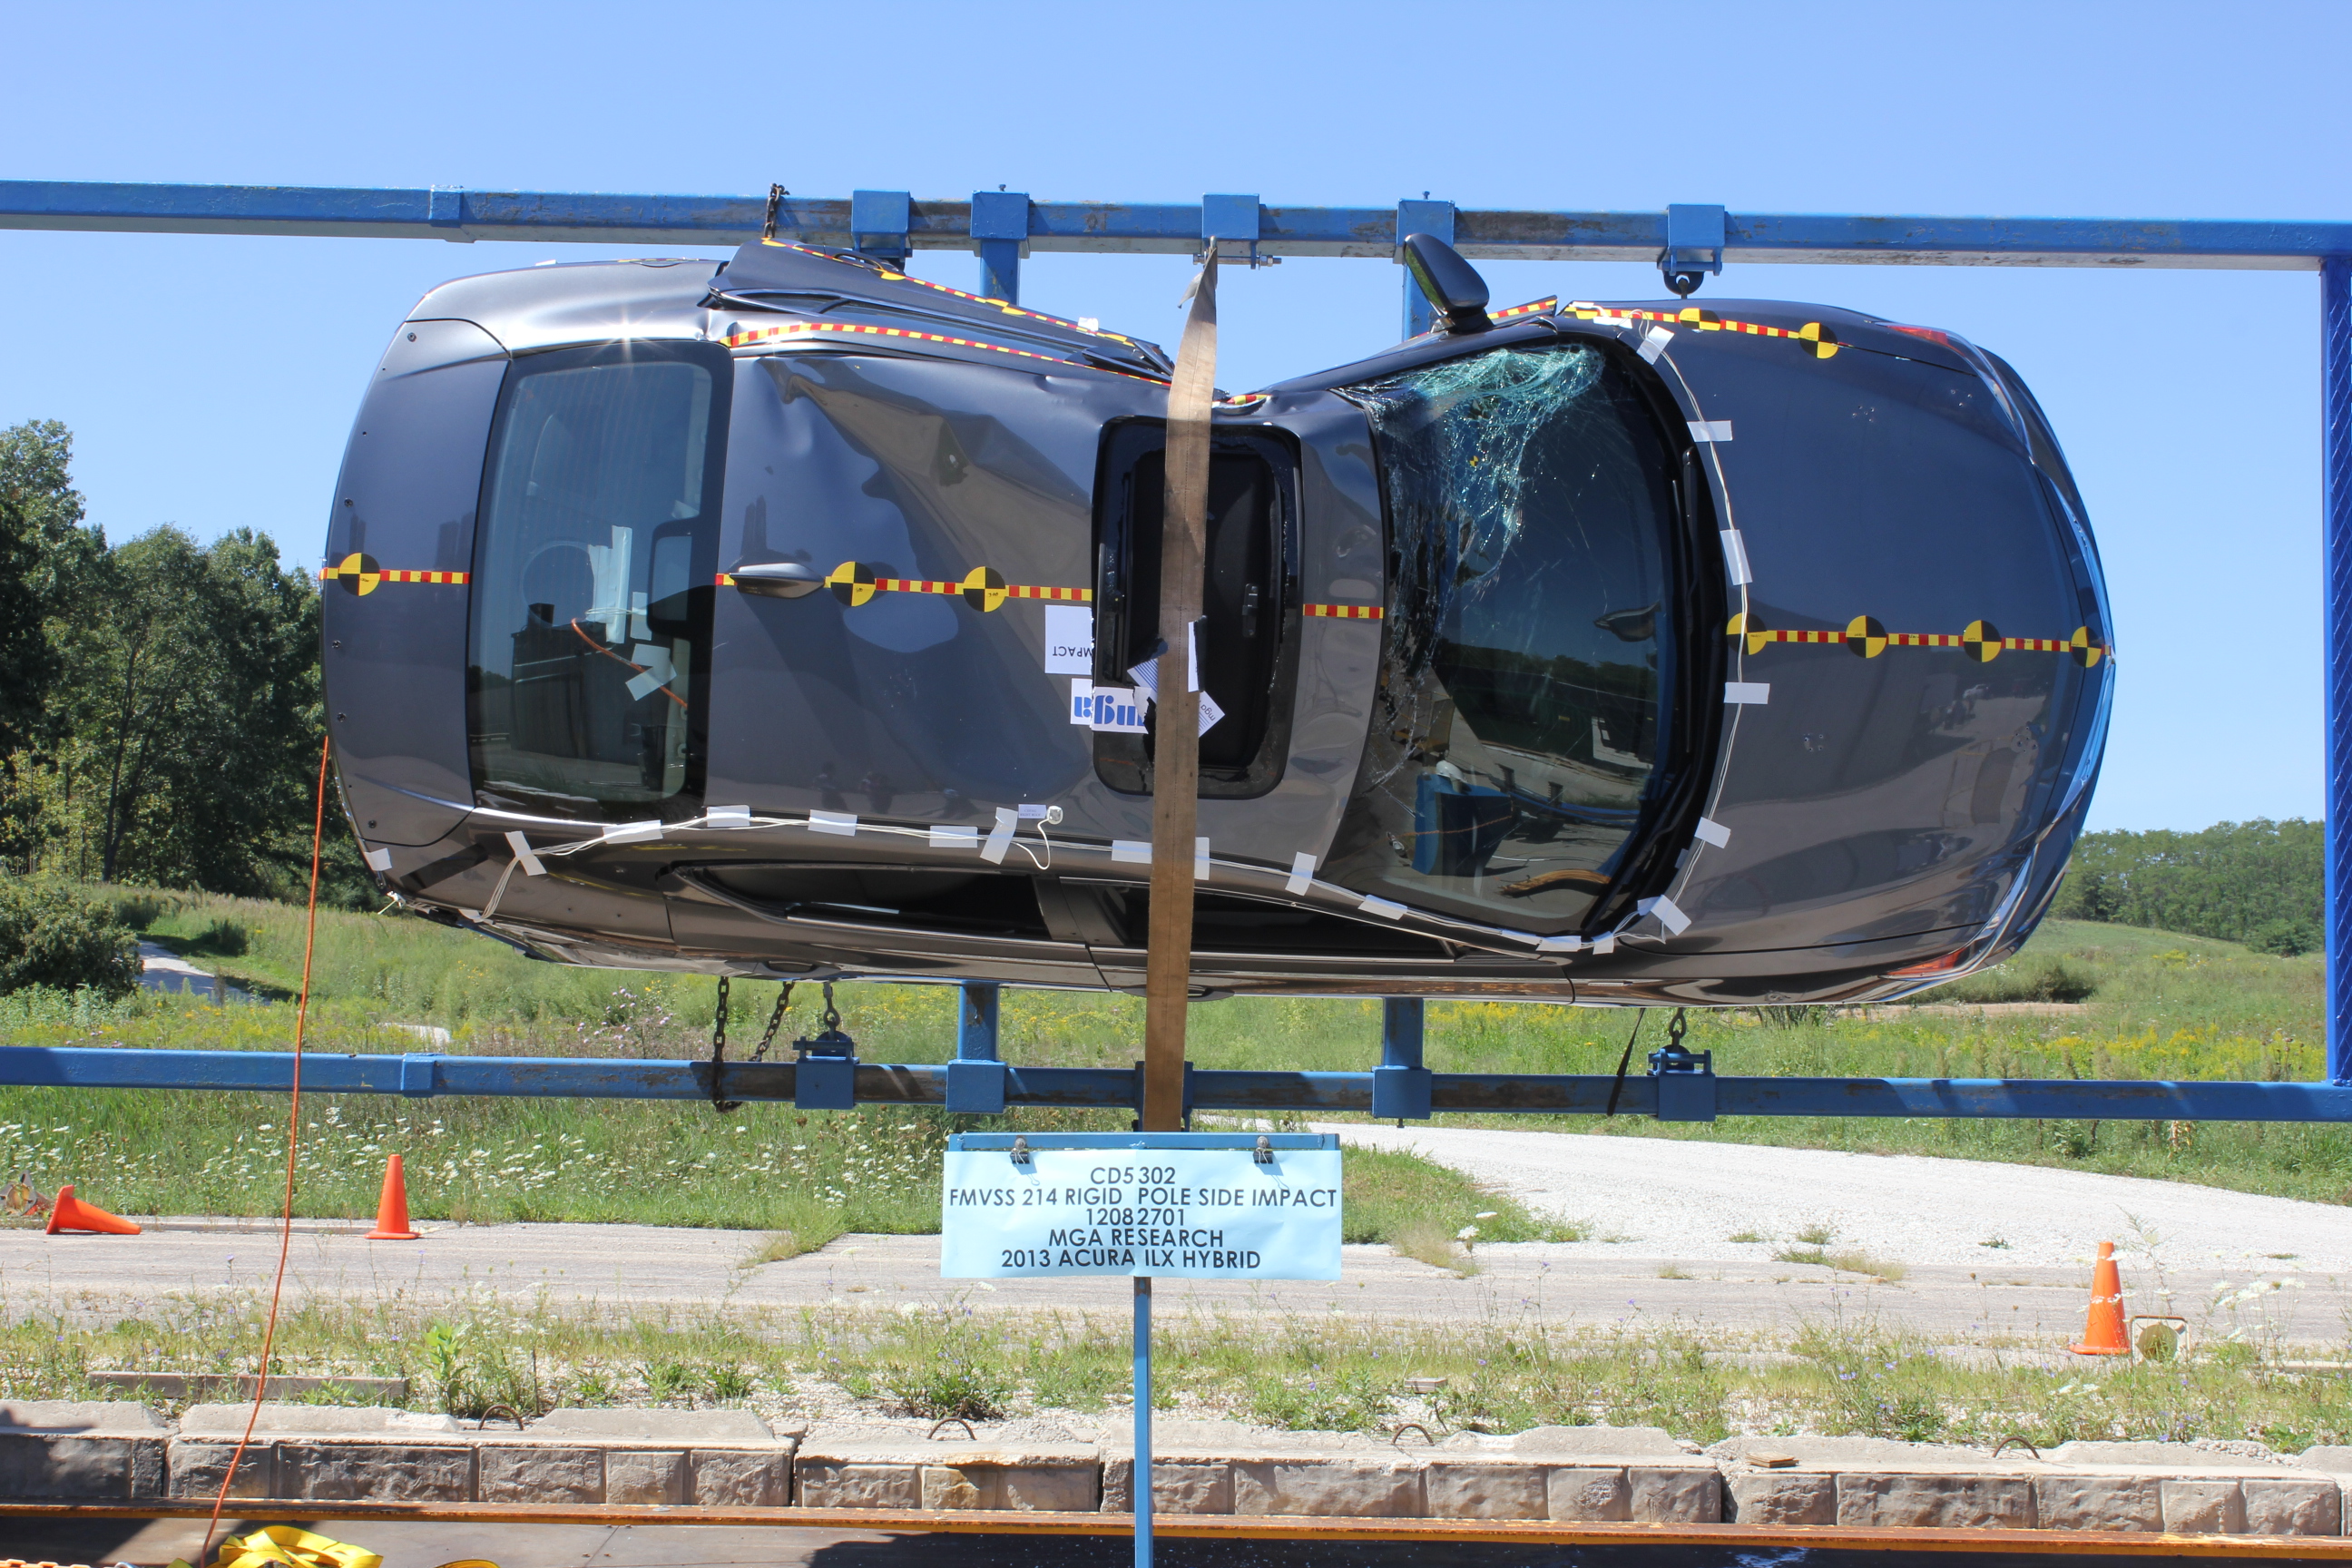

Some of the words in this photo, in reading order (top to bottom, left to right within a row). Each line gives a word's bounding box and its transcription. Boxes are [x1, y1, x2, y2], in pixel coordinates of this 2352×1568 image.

[1052, 645, 1093, 657] MPACT
[1200, 704, 1216, 721] mga
[1090, 1167, 1176, 1184] CD5302
[950, 1189, 1015, 1206] FMVSS
[1023, 1189, 1057, 1205] 214
[1065, 1188, 1122, 1205] RIGID
[1138, 1188, 1191, 1205] POLE
[1199, 1189, 1244, 1206] SIDE
[1252, 1189, 1337, 1207] IMPACT
[1086, 1208, 1185, 1226] 12082701
[1048, 1229, 1103, 1247] MGA
[1112, 1229, 1223, 1248] RESEARCH
[1002, 1250, 1051, 1268] 2013
[1058, 1250, 1135, 1267] ACURA
[1145, 1250, 1175, 1267] ILX
[1182, 1250, 1261, 1269] HYBRID
